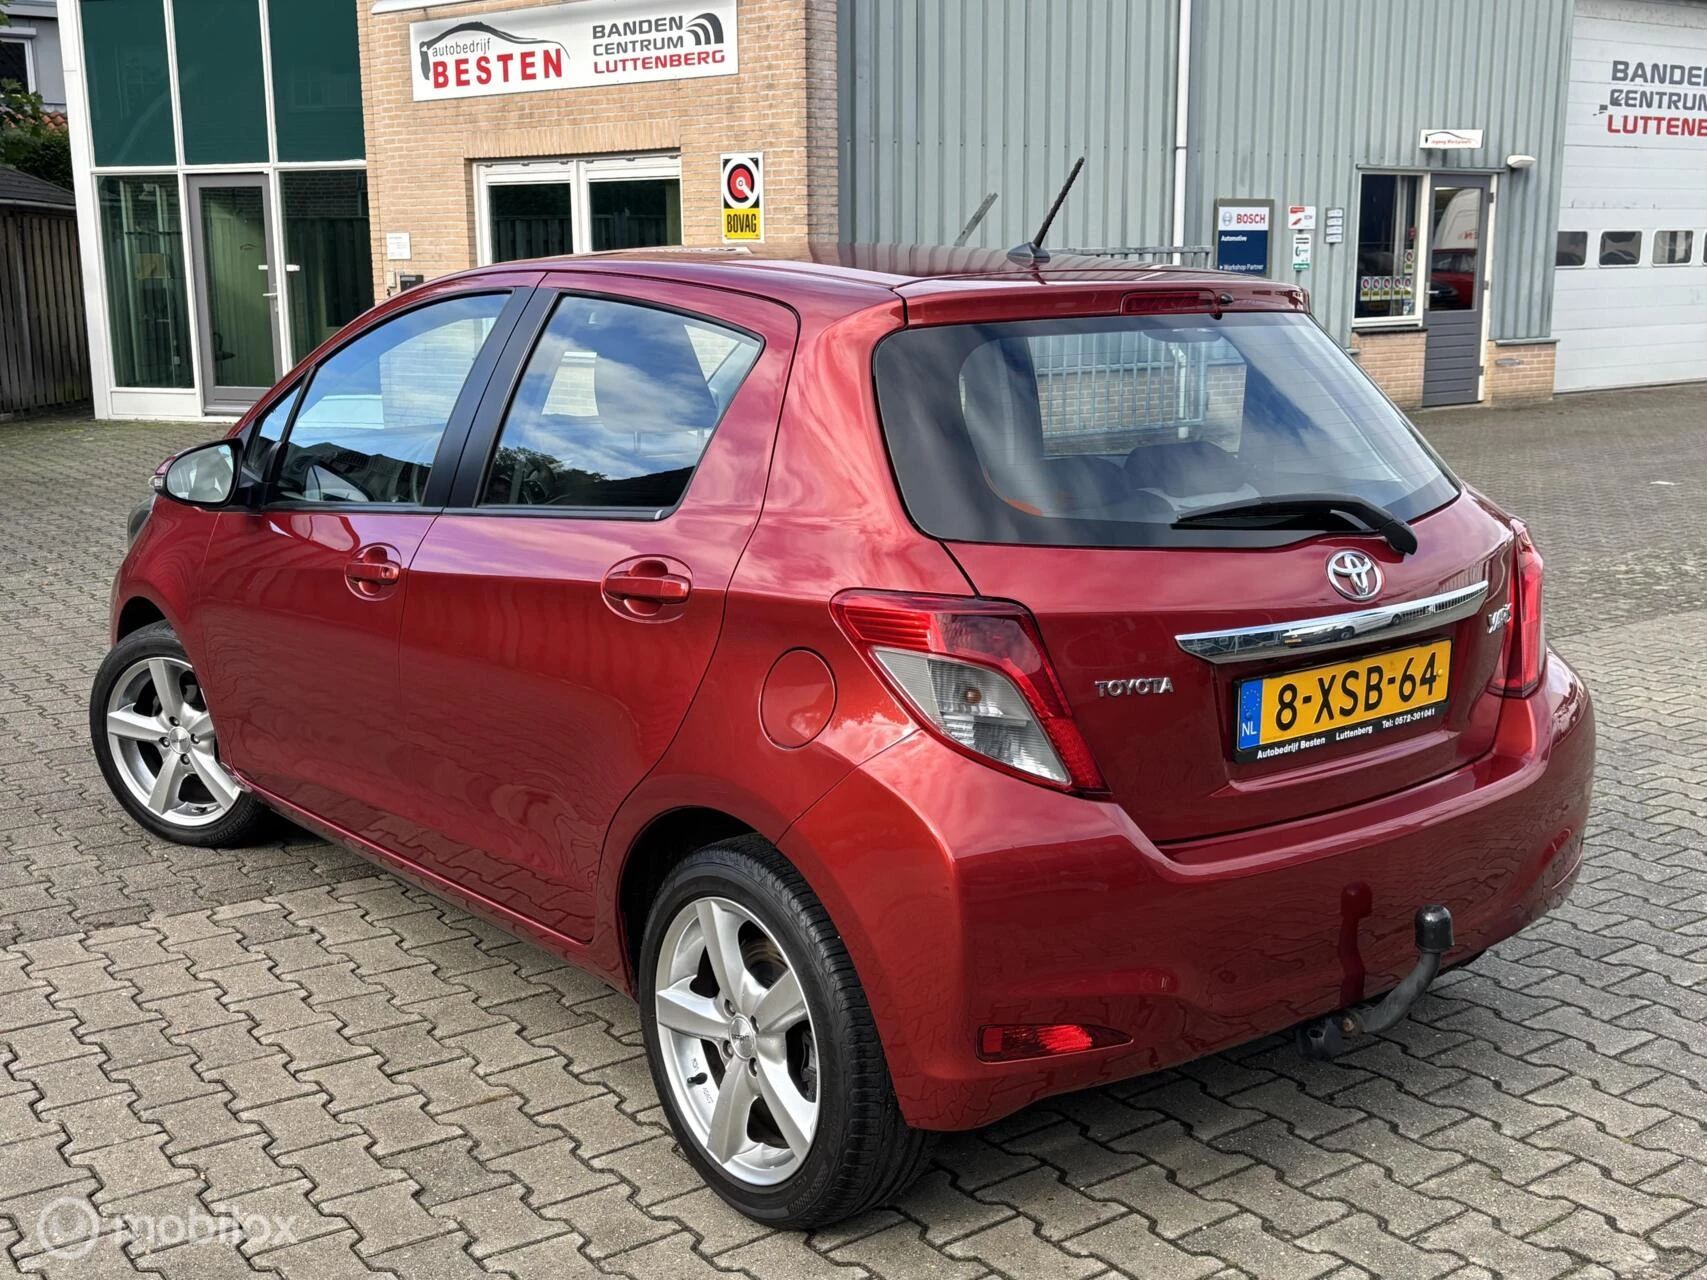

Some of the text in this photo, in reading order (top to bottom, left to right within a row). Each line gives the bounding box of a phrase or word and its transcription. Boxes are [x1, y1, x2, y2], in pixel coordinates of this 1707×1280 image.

[592, 15, 684, 39] BANDEN
[432, 38, 492, 57] autobedrijf
[593, 35, 684, 56] CENTRUM
[433, 48, 563, 89] BESTEN
[594, 50, 725, 74] LUTTENBERG
[1611, 60, 1707, 87] BANDE
[727, 213, 757, 233] BOVAG
[1236, 213, 1266, 225] BOSCH
[1095, 677, 1174, 697] TOYOTA
[1275, 651, 1437, 732] 8-XSB-64
[1241, 722, 1257, 737] NL
[1257, 708, 1435, 759] Autobedrijf Besten Luttenberg Tel: 0572-301041
